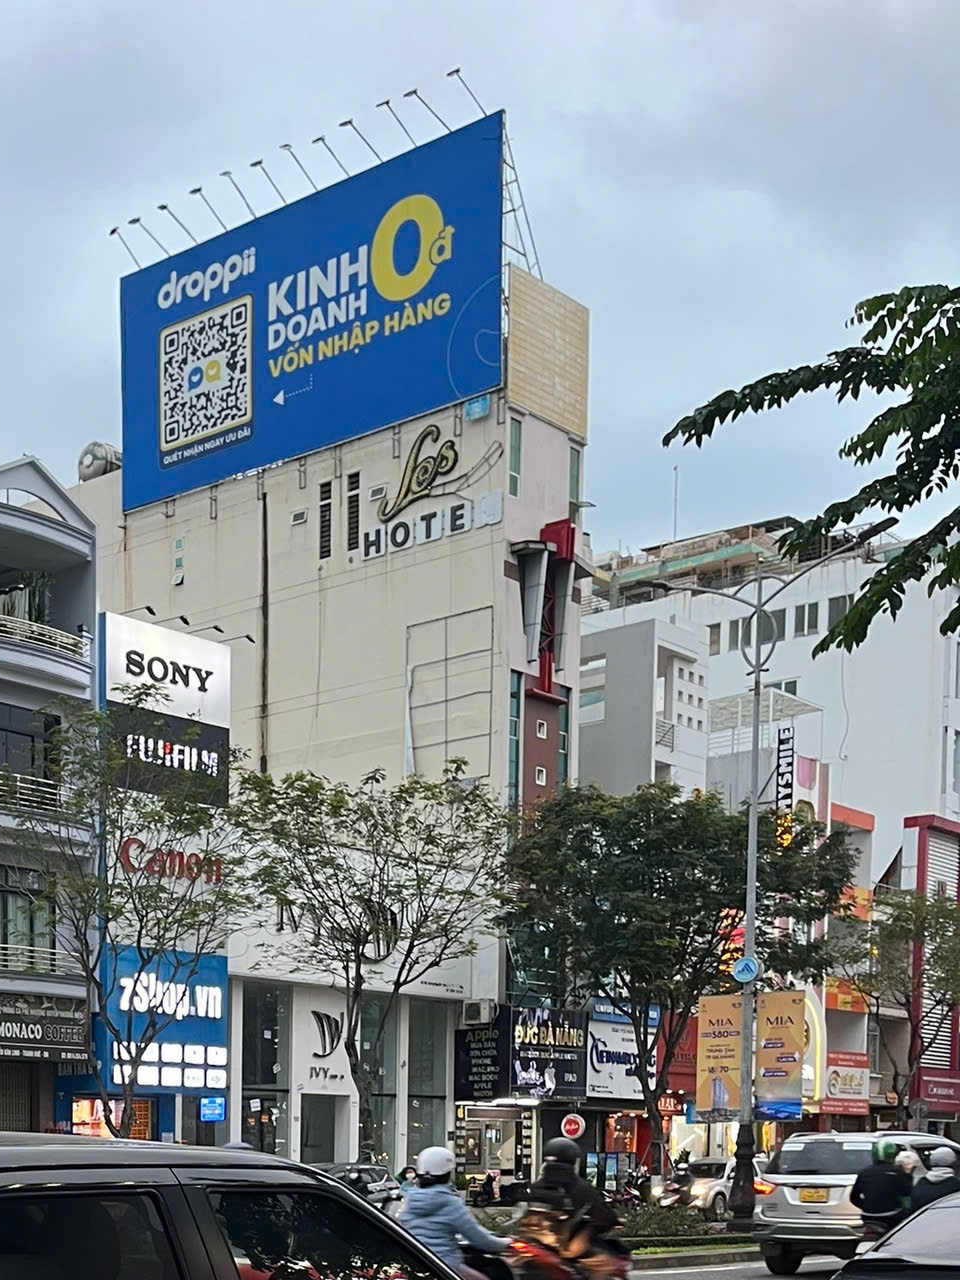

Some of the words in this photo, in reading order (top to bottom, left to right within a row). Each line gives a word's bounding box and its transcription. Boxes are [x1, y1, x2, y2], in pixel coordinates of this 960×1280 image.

[157, 246, 256, 310] droppii
[268, 244, 368, 322] KINH
[268, 288, 367, 351] DOANH
[268, 341, 314, 378] VỐN
[318, 321, 380, 355] NHẬP
[384, 293, 451, 336] HÀNG
[363, 503, 465, 557] HOTE
[125, 650, 213, 693] SONY
[119, 837, 222, 884] Canon
[44, 1024, 83, 1042] COFFEE
[465, 1029, 499, 1042] Apple
[708, 1018, 733, 1028] MIA
[766, 1016, 794, 1026] MIA
